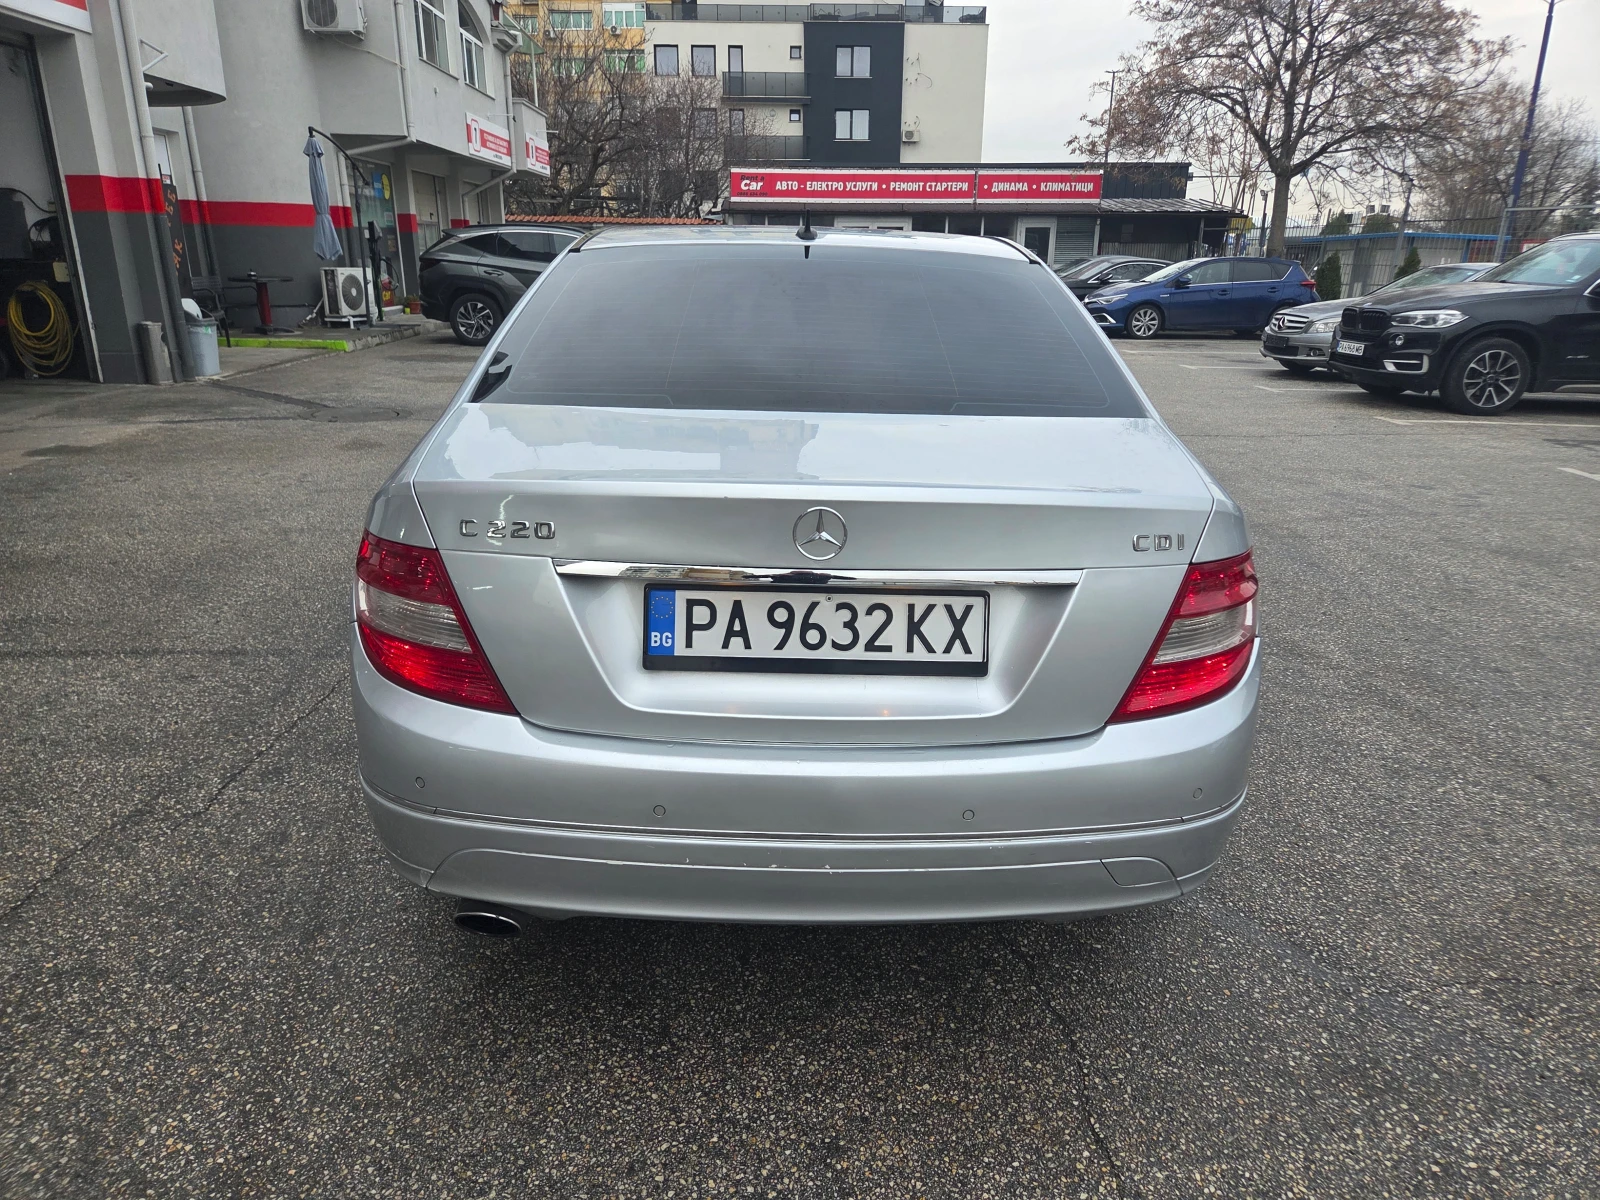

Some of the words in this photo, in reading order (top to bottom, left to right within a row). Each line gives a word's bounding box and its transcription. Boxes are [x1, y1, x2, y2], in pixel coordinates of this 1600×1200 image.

[741, 180, 763, 190] Car
[775, 181, 798, 191] АВТО
[806, 181, 844, 191] ЕЛЕКТРО
[846, 181, 878, 191] УСЛУГИ
[889, 182, 924, 192] РЕМОНТ
[926, 182, 969, 192] СТАРТЕРИ
[991, 182, 1028, 193] ДИНАМА
[1040, 182, 1094, 193] КЛИМАТИЦИ
[459, 518, 478, 537] C
[487, 520, 556, 539] 220
[1132, 533, 1185, 552] CDI
[766, 600, 893, 652] 9632
[650, 631, 672, 647] BG
